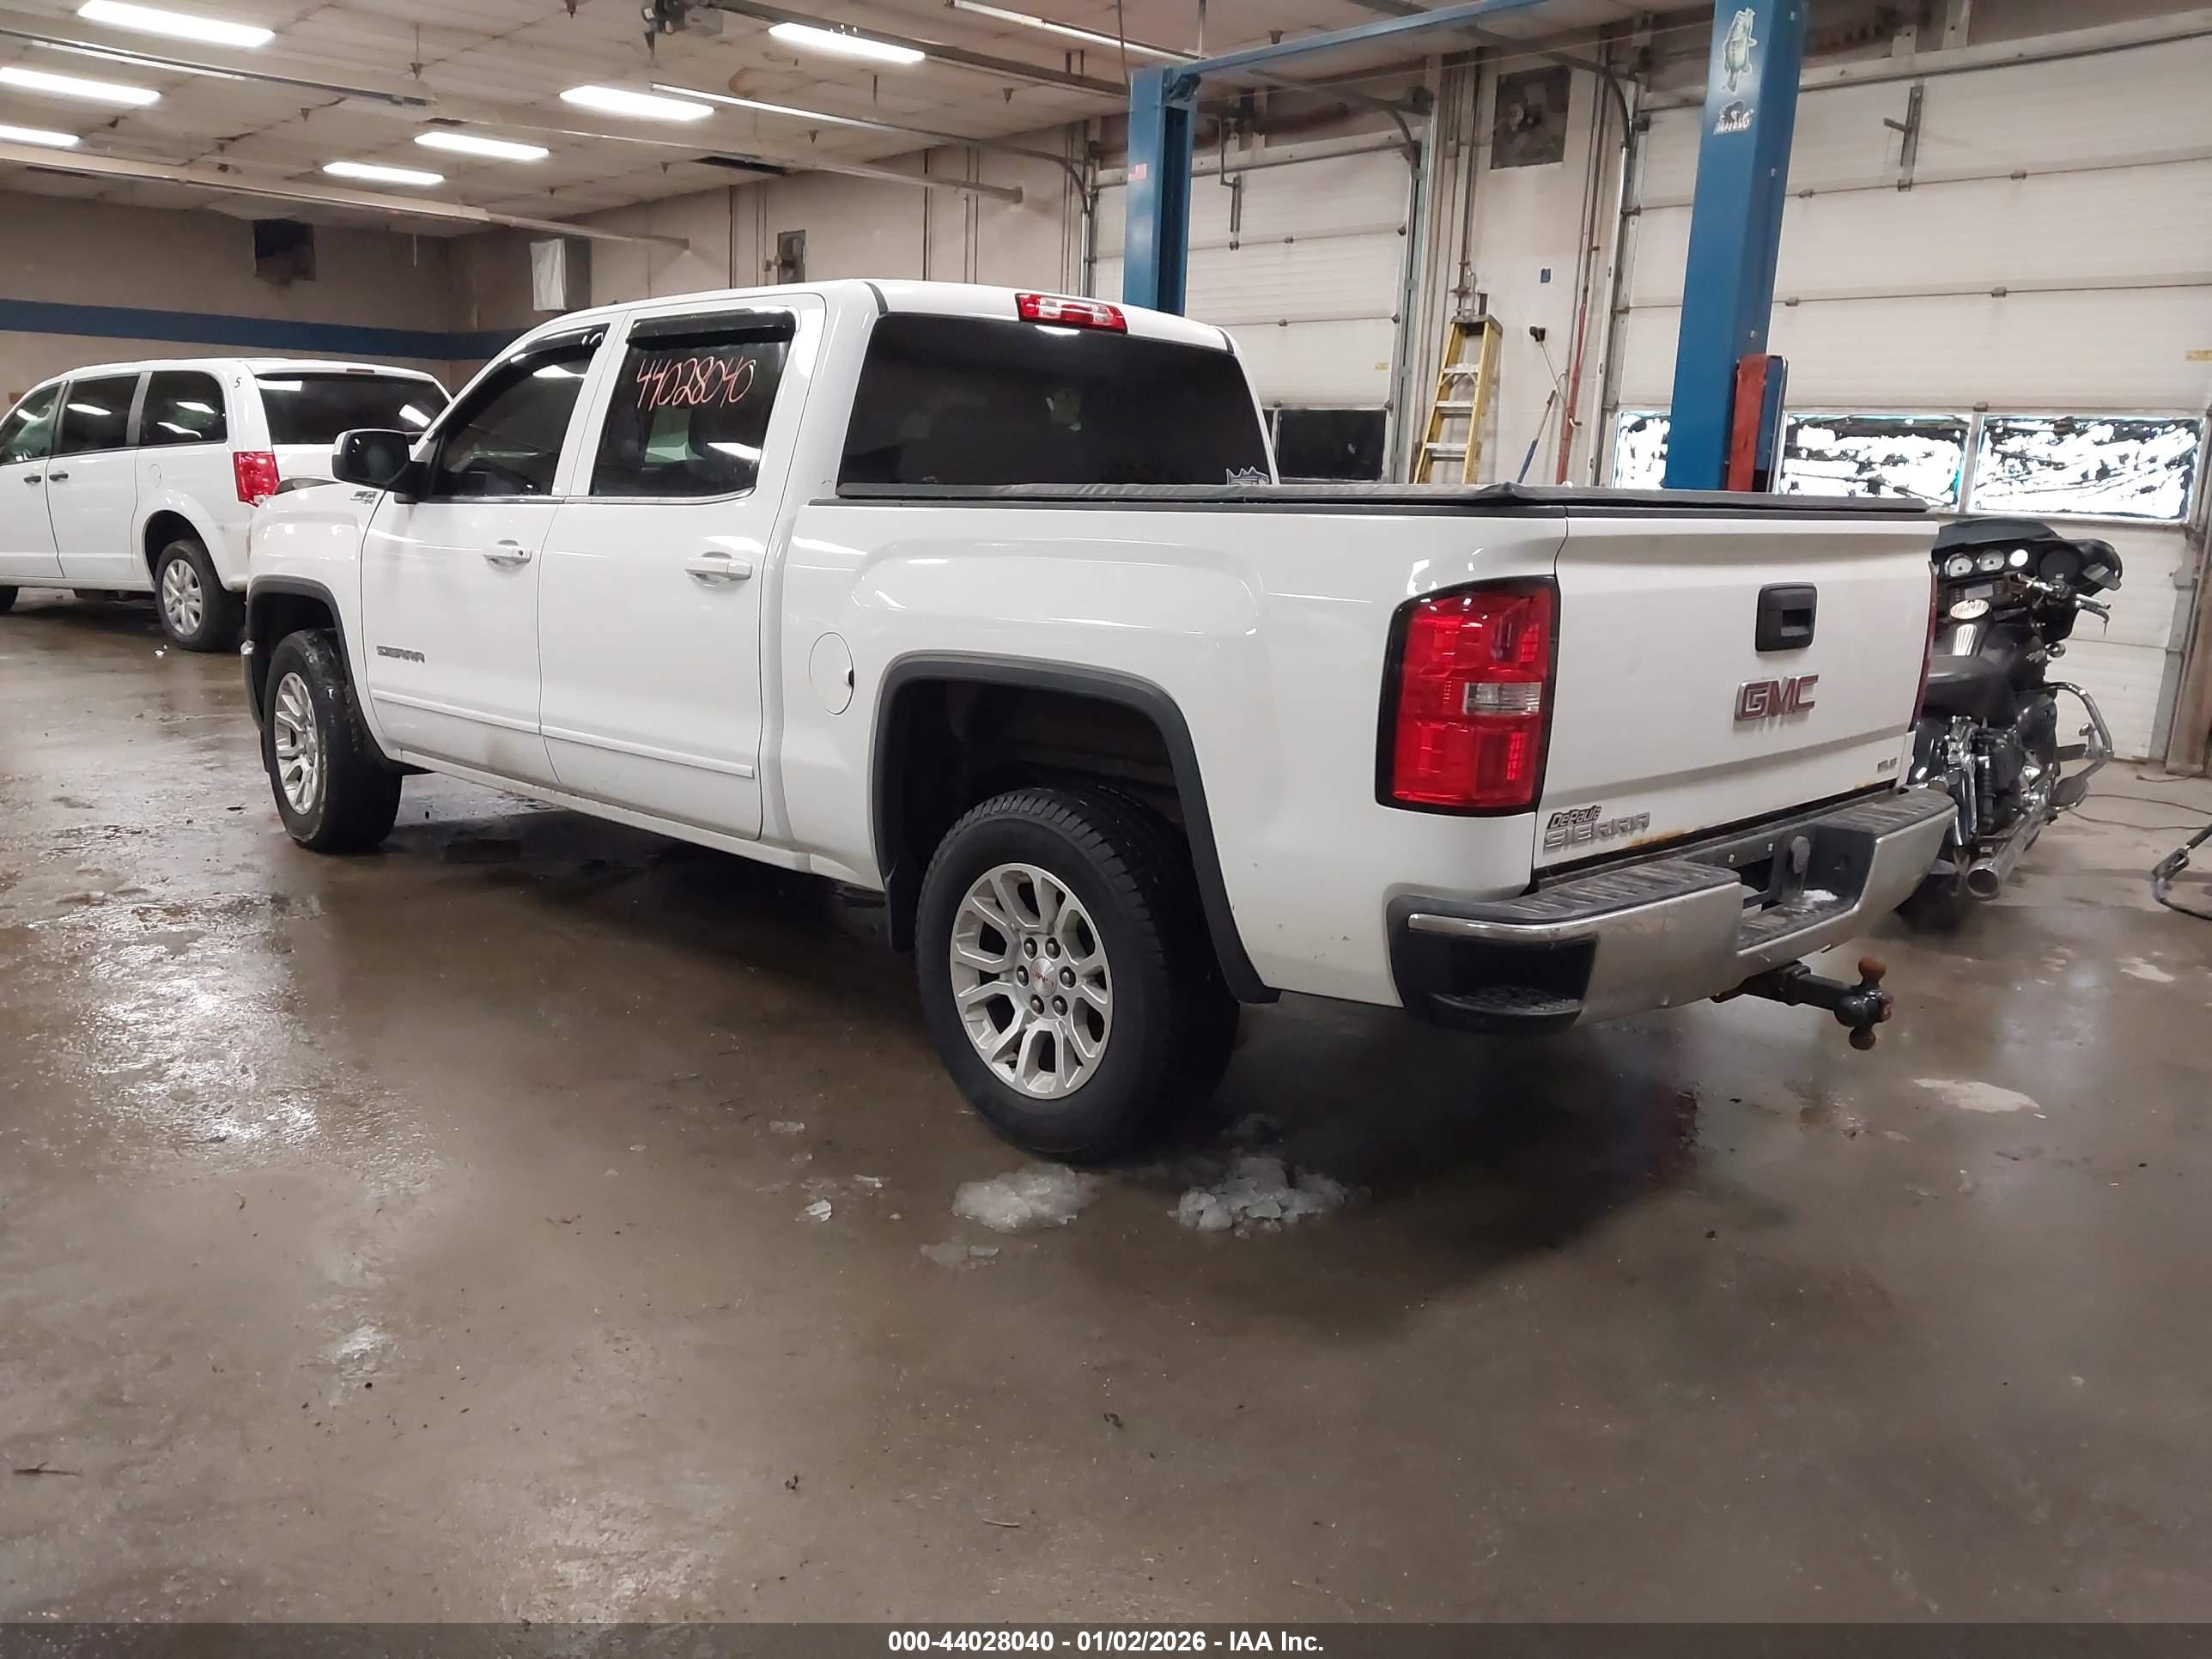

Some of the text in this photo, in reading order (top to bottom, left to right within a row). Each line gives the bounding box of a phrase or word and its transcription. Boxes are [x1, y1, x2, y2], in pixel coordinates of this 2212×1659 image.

[636, 356, 757, 411] 44028040
[1735, 674, 1819, 721] GMC
[1545, 812, 1650, 848] SIERRA
[1547, 805, 1602, 829] DePaula
